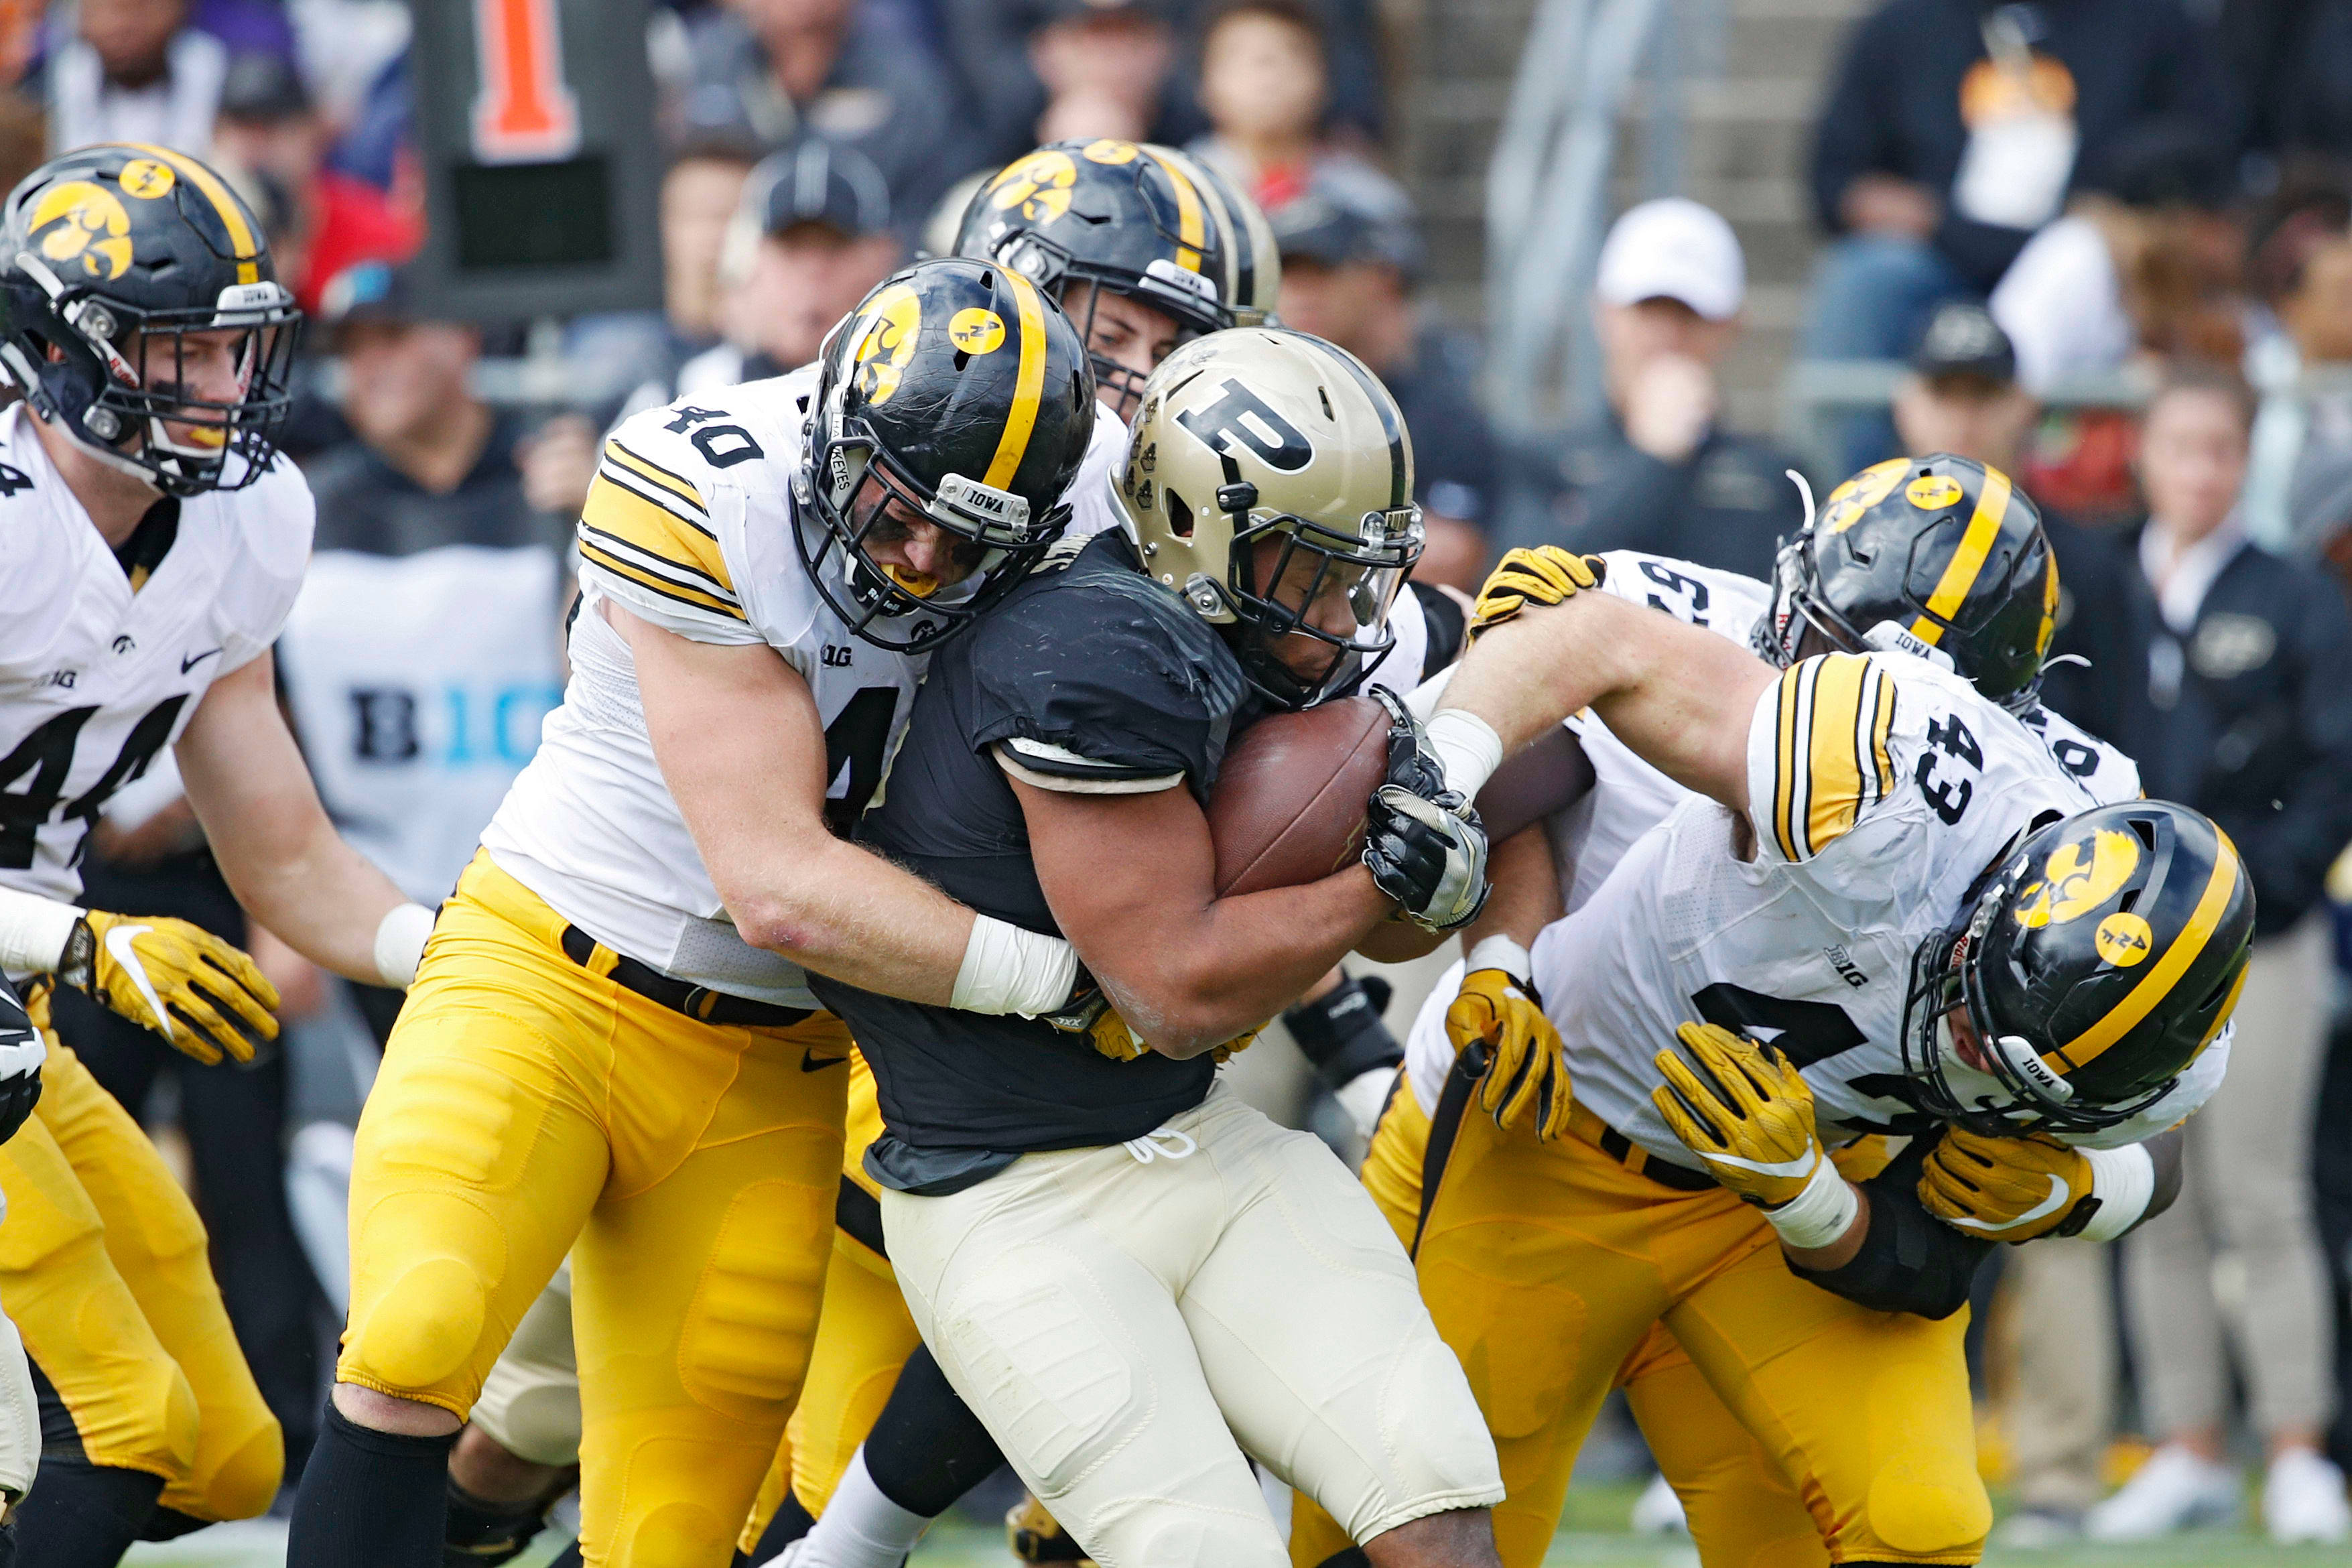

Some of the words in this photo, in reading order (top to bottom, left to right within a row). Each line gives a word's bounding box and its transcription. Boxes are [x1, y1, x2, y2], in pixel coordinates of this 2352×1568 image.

[954, 320, 1000, 342] ANF
[663, 405, 765, 469] 40
[832, 420, 851, 491] HAKEYES
[967, 490, 1004, 514] IOWA
[1895, 633, 1931, 661] IOWA
[1914, 713, 1983, 826] 43
[2102, 928, 2147, 951] ANF
[2022, 1057, 2055, 1088] IOWA
